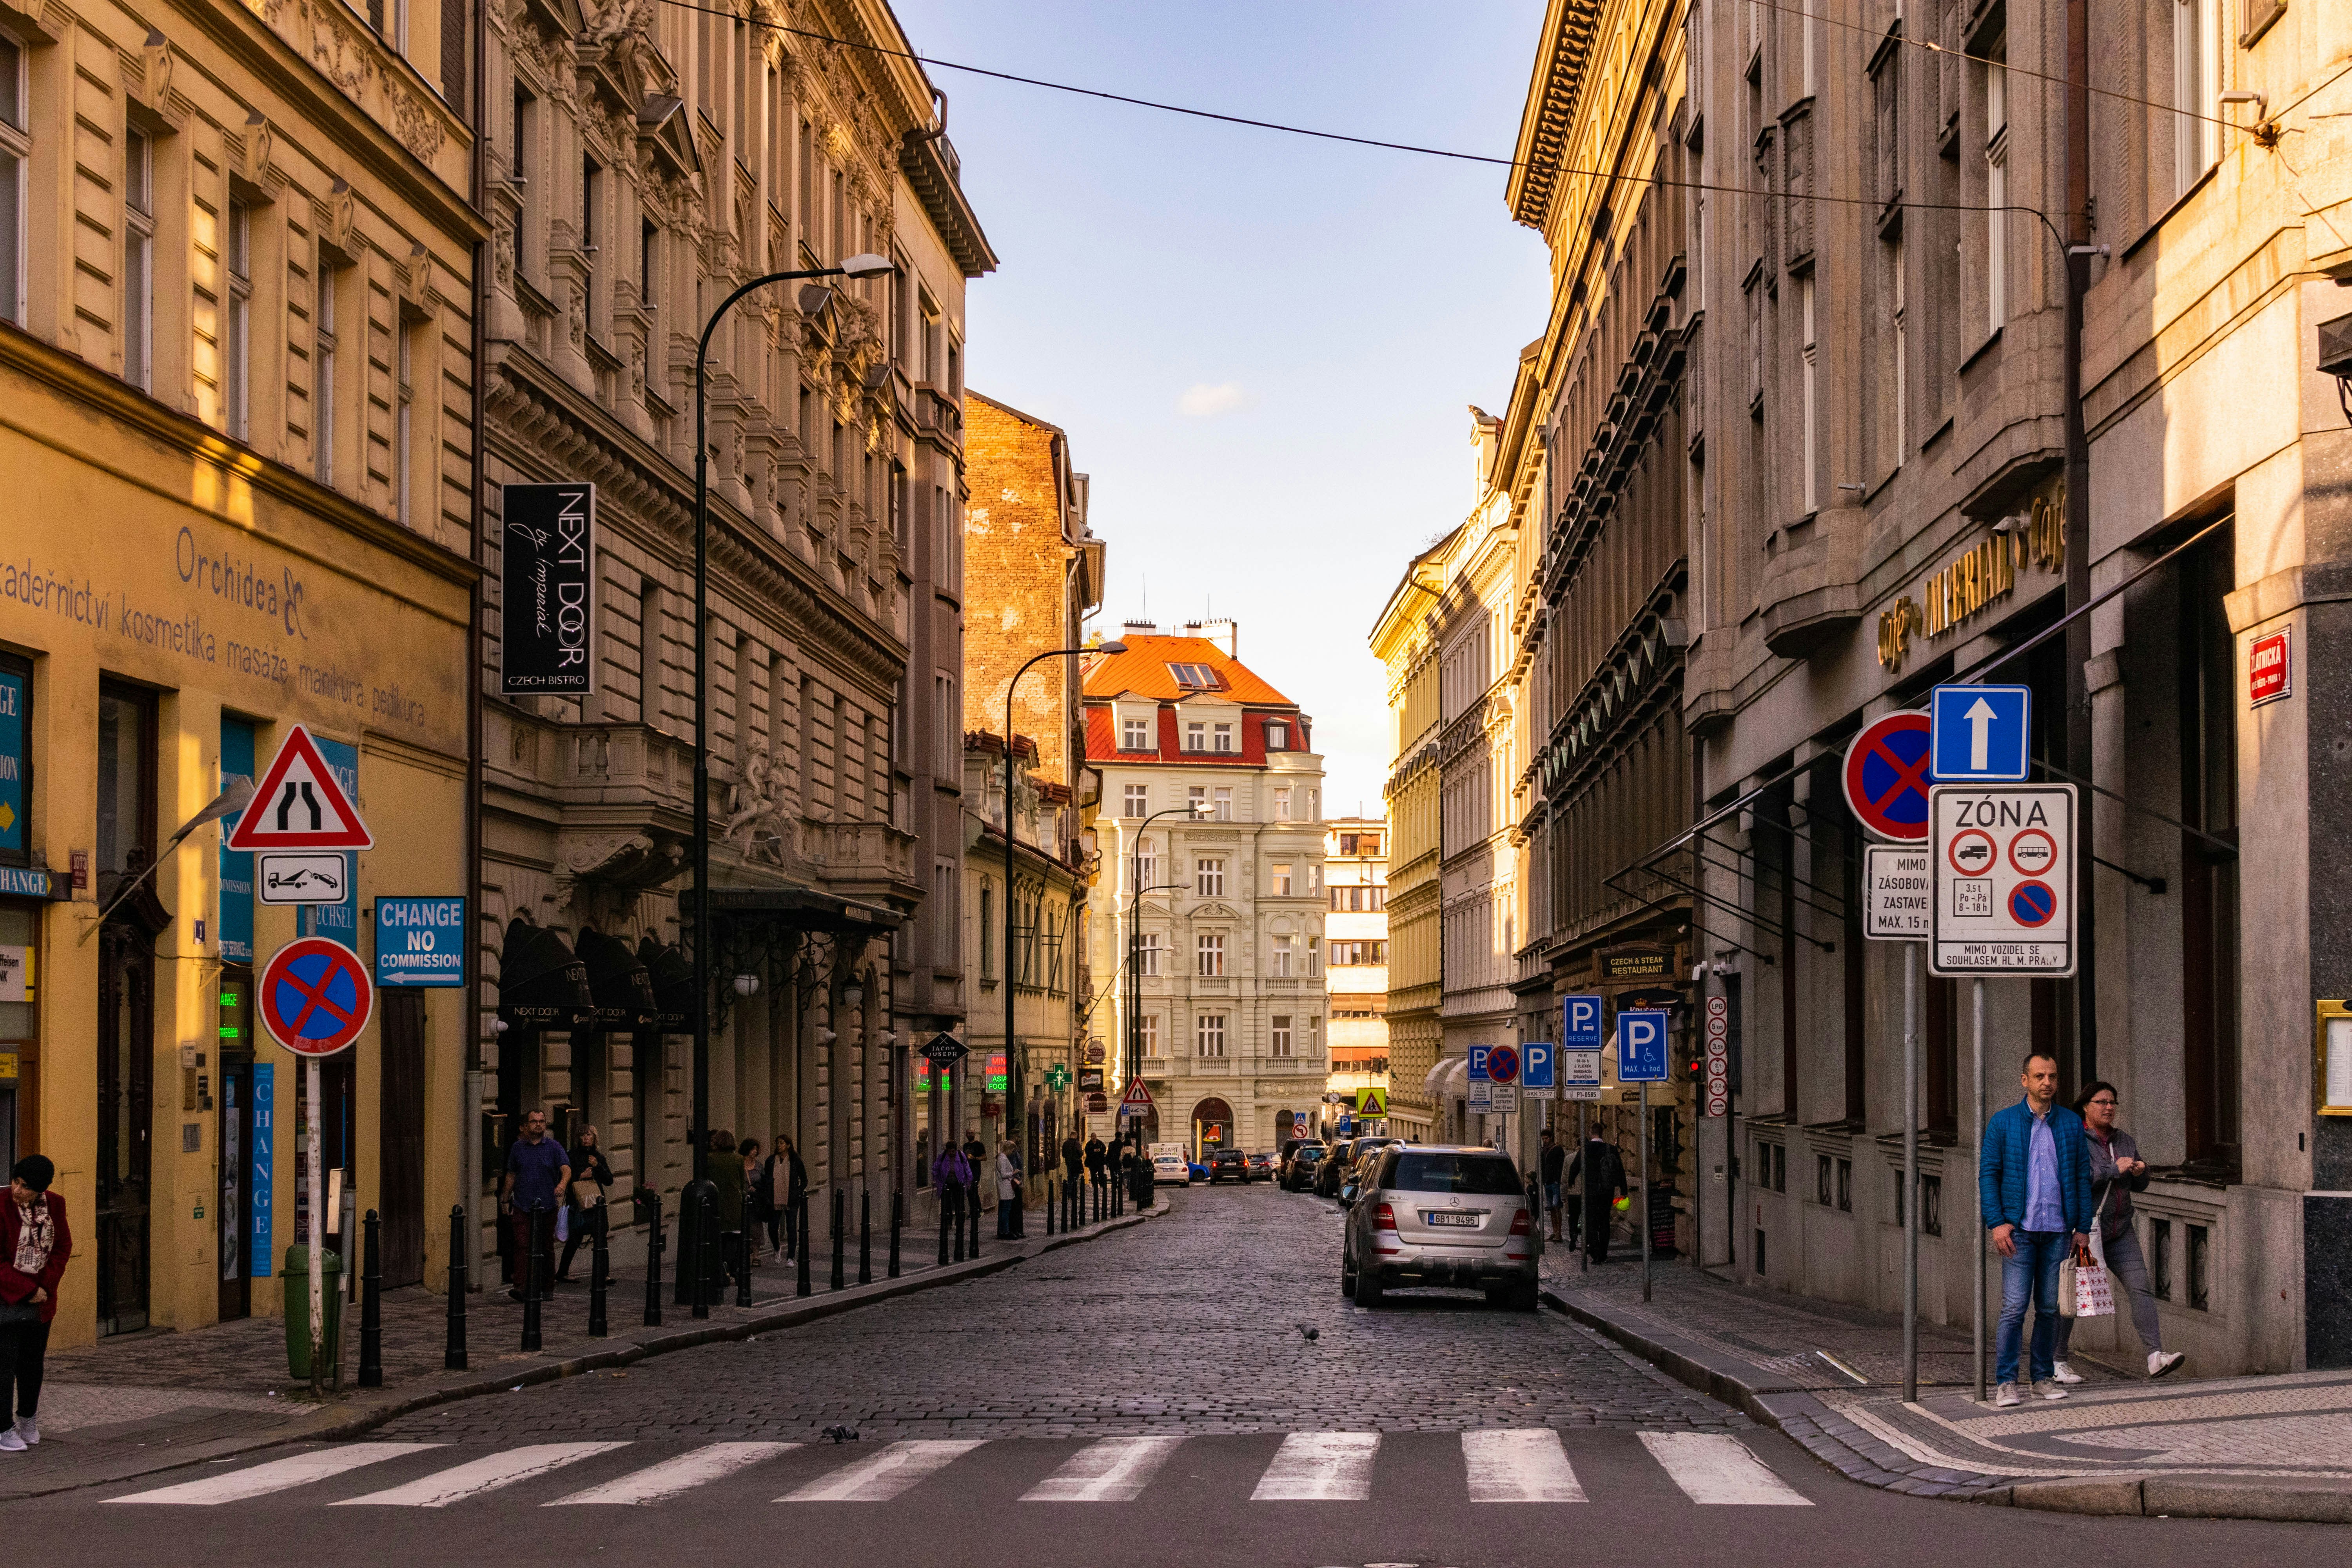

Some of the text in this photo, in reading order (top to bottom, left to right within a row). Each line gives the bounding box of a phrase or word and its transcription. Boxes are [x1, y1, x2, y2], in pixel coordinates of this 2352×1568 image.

[177, 526, 277, 615] Orchidea
[559, 493, 584, 668] NEXT DOOR
[1924, 535, 2014, 640] IMPERIAL
[121, 593, 215, 663] kosmetika
[227, 641, 288, 684] masáže
[299, 662, 364, 707] manikúra
[373, 683, 424, 726] pedikúra
[2251, 641, 2281, 674] ZLATNICKÁ
[508, 675, 584, 686] CZECH BISTRO
[2268, 673, 2278, 684] PRAHA
[2278, 673, 2281, 681] 1
[1956, 795, 2048, 827] ZÓNA
[1898, 858, 1926, 871] MIMO
[1966, 884, 1976, 893] 3,5
[1884, 897, 1928, 909] ZASTAVE
[1978, 893, 1986, 902] Pá
[1959, 903, 1964, 911] 8
[1973, 903, 1981, 911] 18
[1983, 903, 1987, 911] h
[381, 903, 461, 927] CHANGE
[1878, 916, 1904, 928] MAX.
[1908, 916, 1920, 928] 15
[408, 931, 435, 951] NO
[1964, 945, 2040, 954] MIMO VOZIDEL SE
[381, 954, 461, 967] COMMISSION
[1947, 956, 1997, 965] SOUHLASEM
[2002, 956, 2014, 965] HL.
[2017, 956, 2026, 965] M.
[1612, 965, 1663, 975] RESTAURANT
[514, 1007, 560, 1016] NEXT DOOR
[1573, 1002, 1593, 1031] P
[1629, 1021, 1655, 1059] P
[1474, 1049, 1488, 1069] P
[1529, 1048, 1547, 1073] P
[1341, 1117, 1348, 1127] P
[254, 1083, 271, 1234] CHANGE
[1435, 1215, 1475, 1224] 6B1 9495
